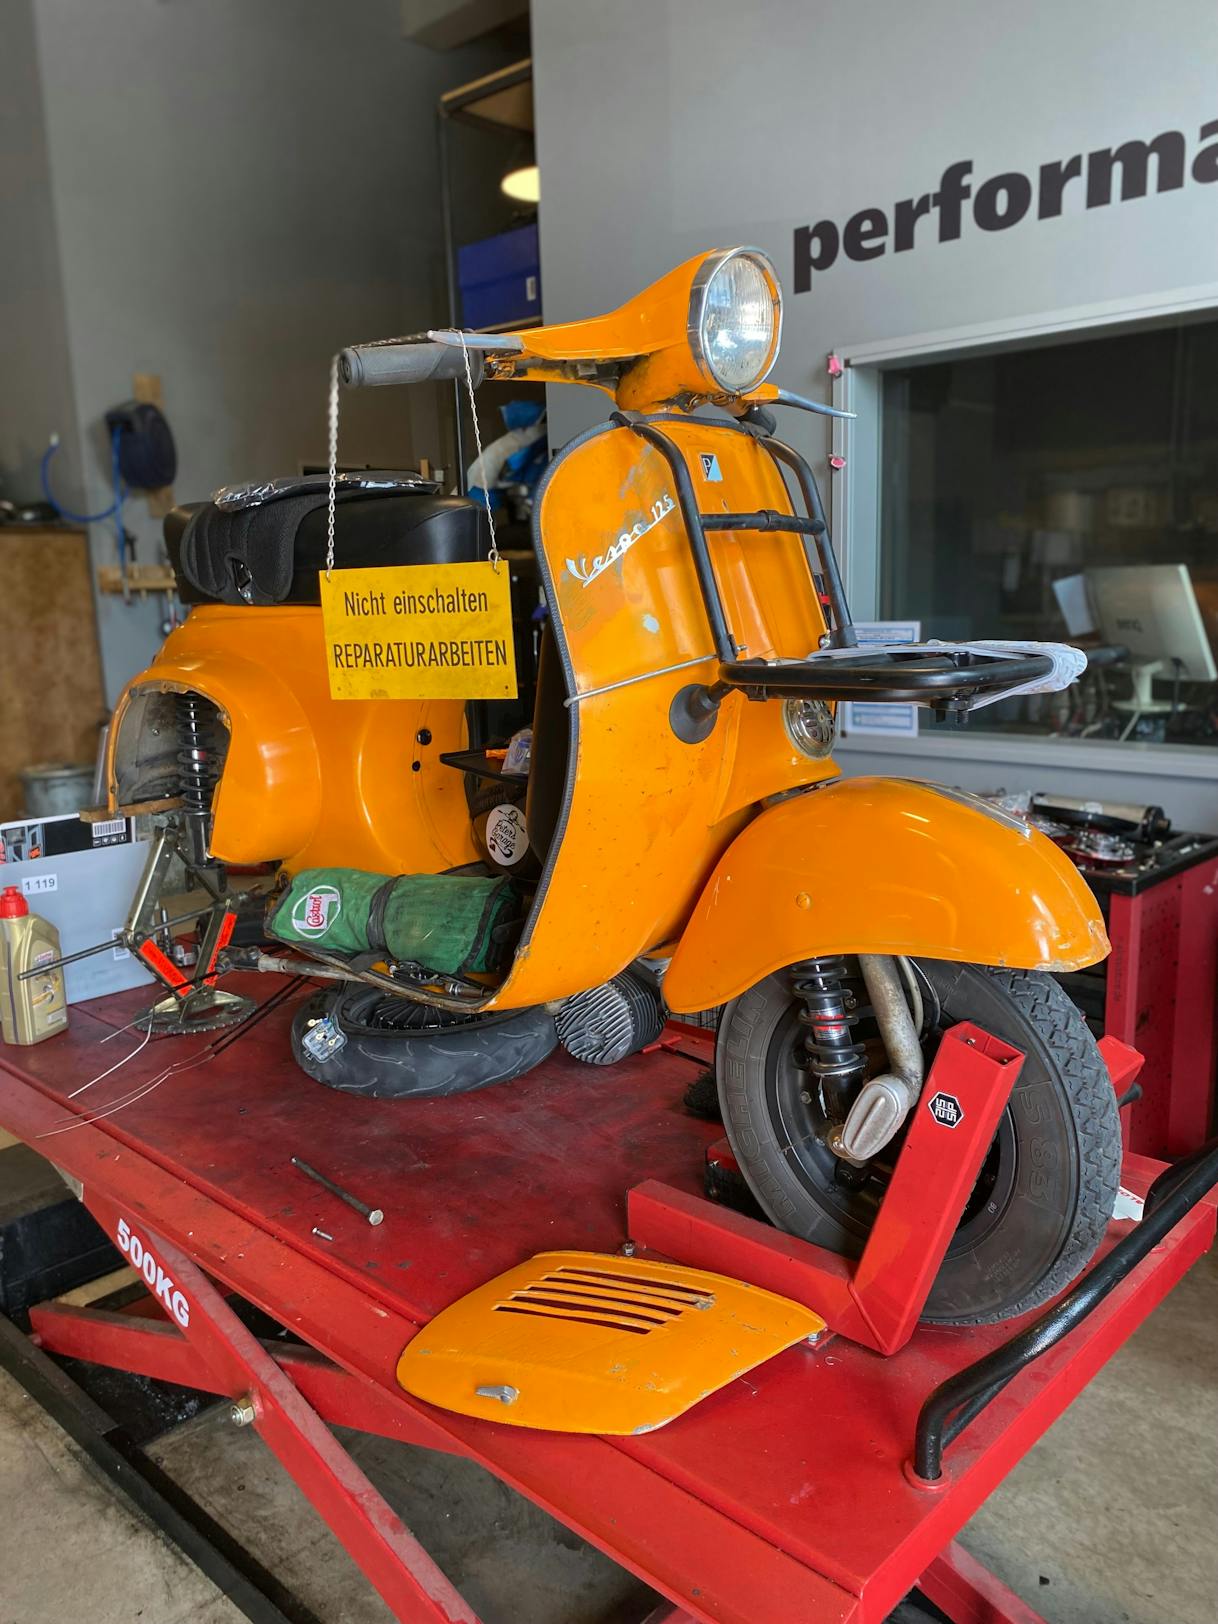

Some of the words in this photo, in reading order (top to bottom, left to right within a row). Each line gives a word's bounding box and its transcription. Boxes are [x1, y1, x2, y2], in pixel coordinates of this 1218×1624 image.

[565, 523, 651, 588] Vespa
[651, 494, 676, 523] 125
[344, 590, 387, 616] Nicht
[393, 587, 488, 616] einschalten
[333, 639, 508, 669] REPARATURARBEITEN
[35, 878, 55, 889] 119
[307, 895, 325, 927] Castrol
[117, 1218, 190, 1327] 500KG
